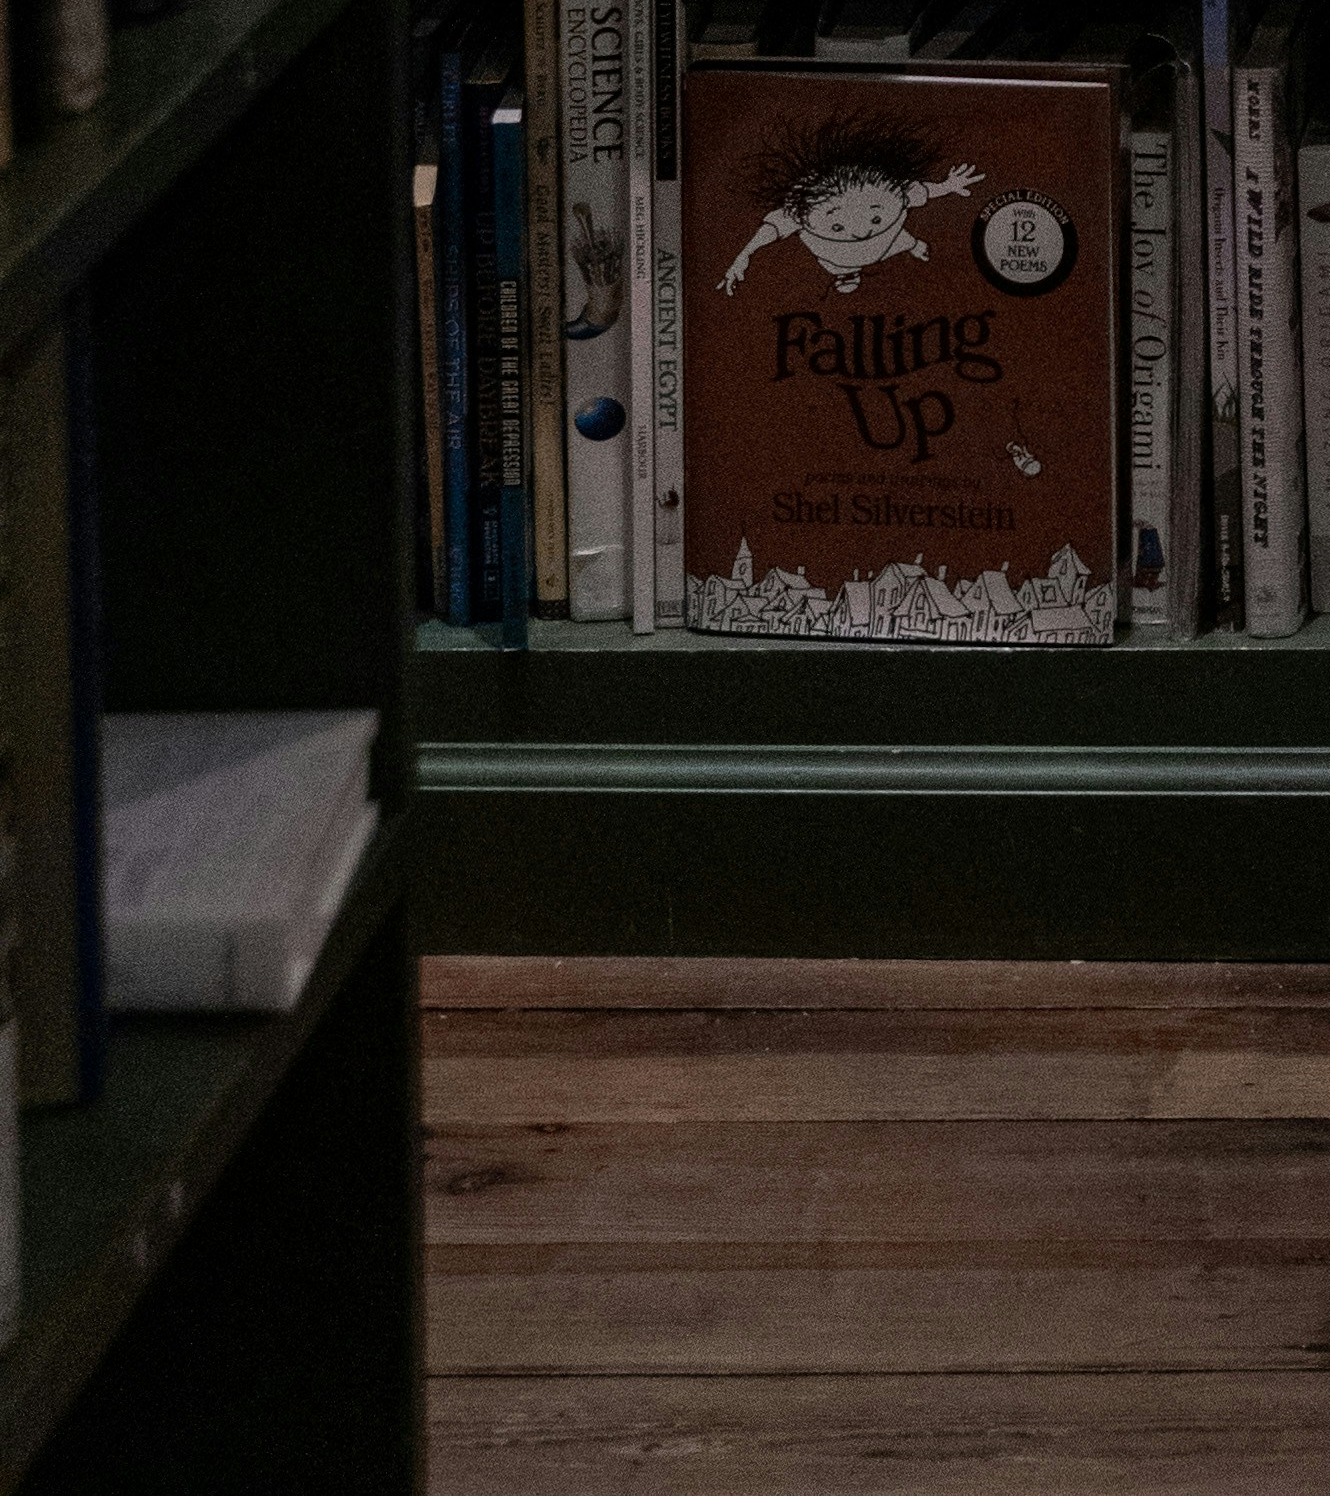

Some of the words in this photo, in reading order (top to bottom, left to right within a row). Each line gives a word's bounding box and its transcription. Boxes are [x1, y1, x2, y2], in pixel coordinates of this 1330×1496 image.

[772, 311, 1003, 383] Falling
[837, 382, 954, 464] Up
[772, 492, 840, 524] Shel
[851, 494, 1016, 531] Silverstein
